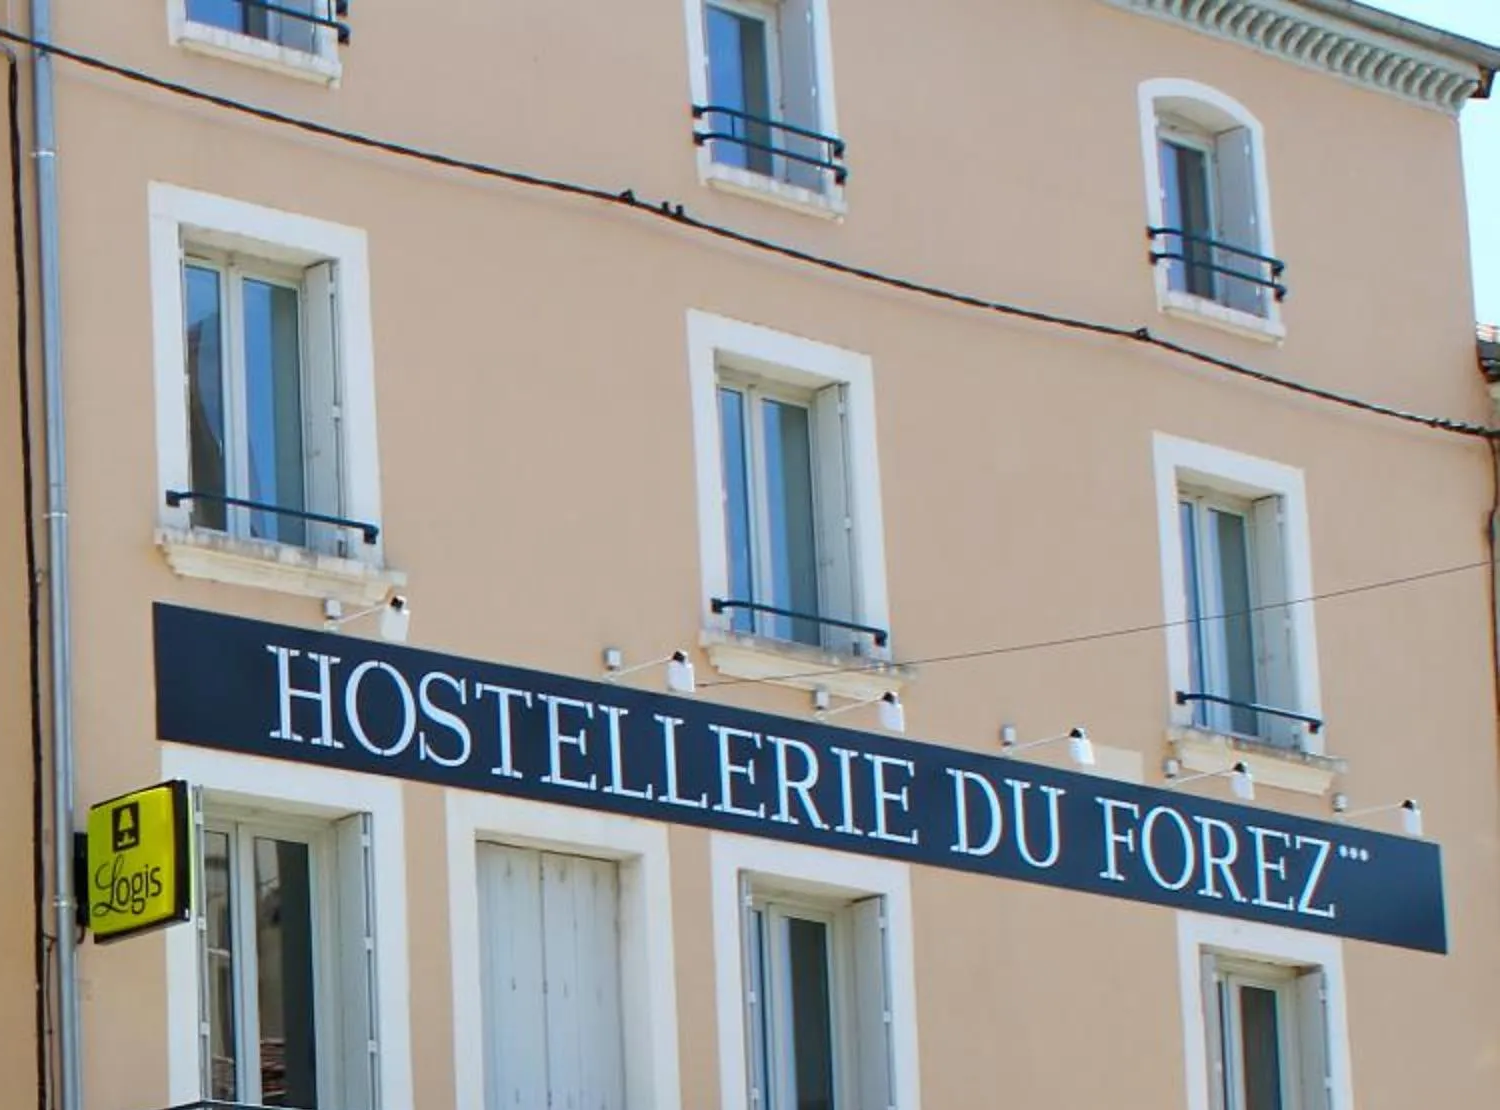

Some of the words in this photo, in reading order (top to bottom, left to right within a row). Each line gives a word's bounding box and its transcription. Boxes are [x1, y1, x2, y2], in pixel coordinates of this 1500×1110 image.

[266, 644, 919, 846] HOSTELLERIE
[946, 767, 1067, 870] DU
[1094, 796, 1336, 920] FOREZ
[92, 854, 162, 917] Logis
